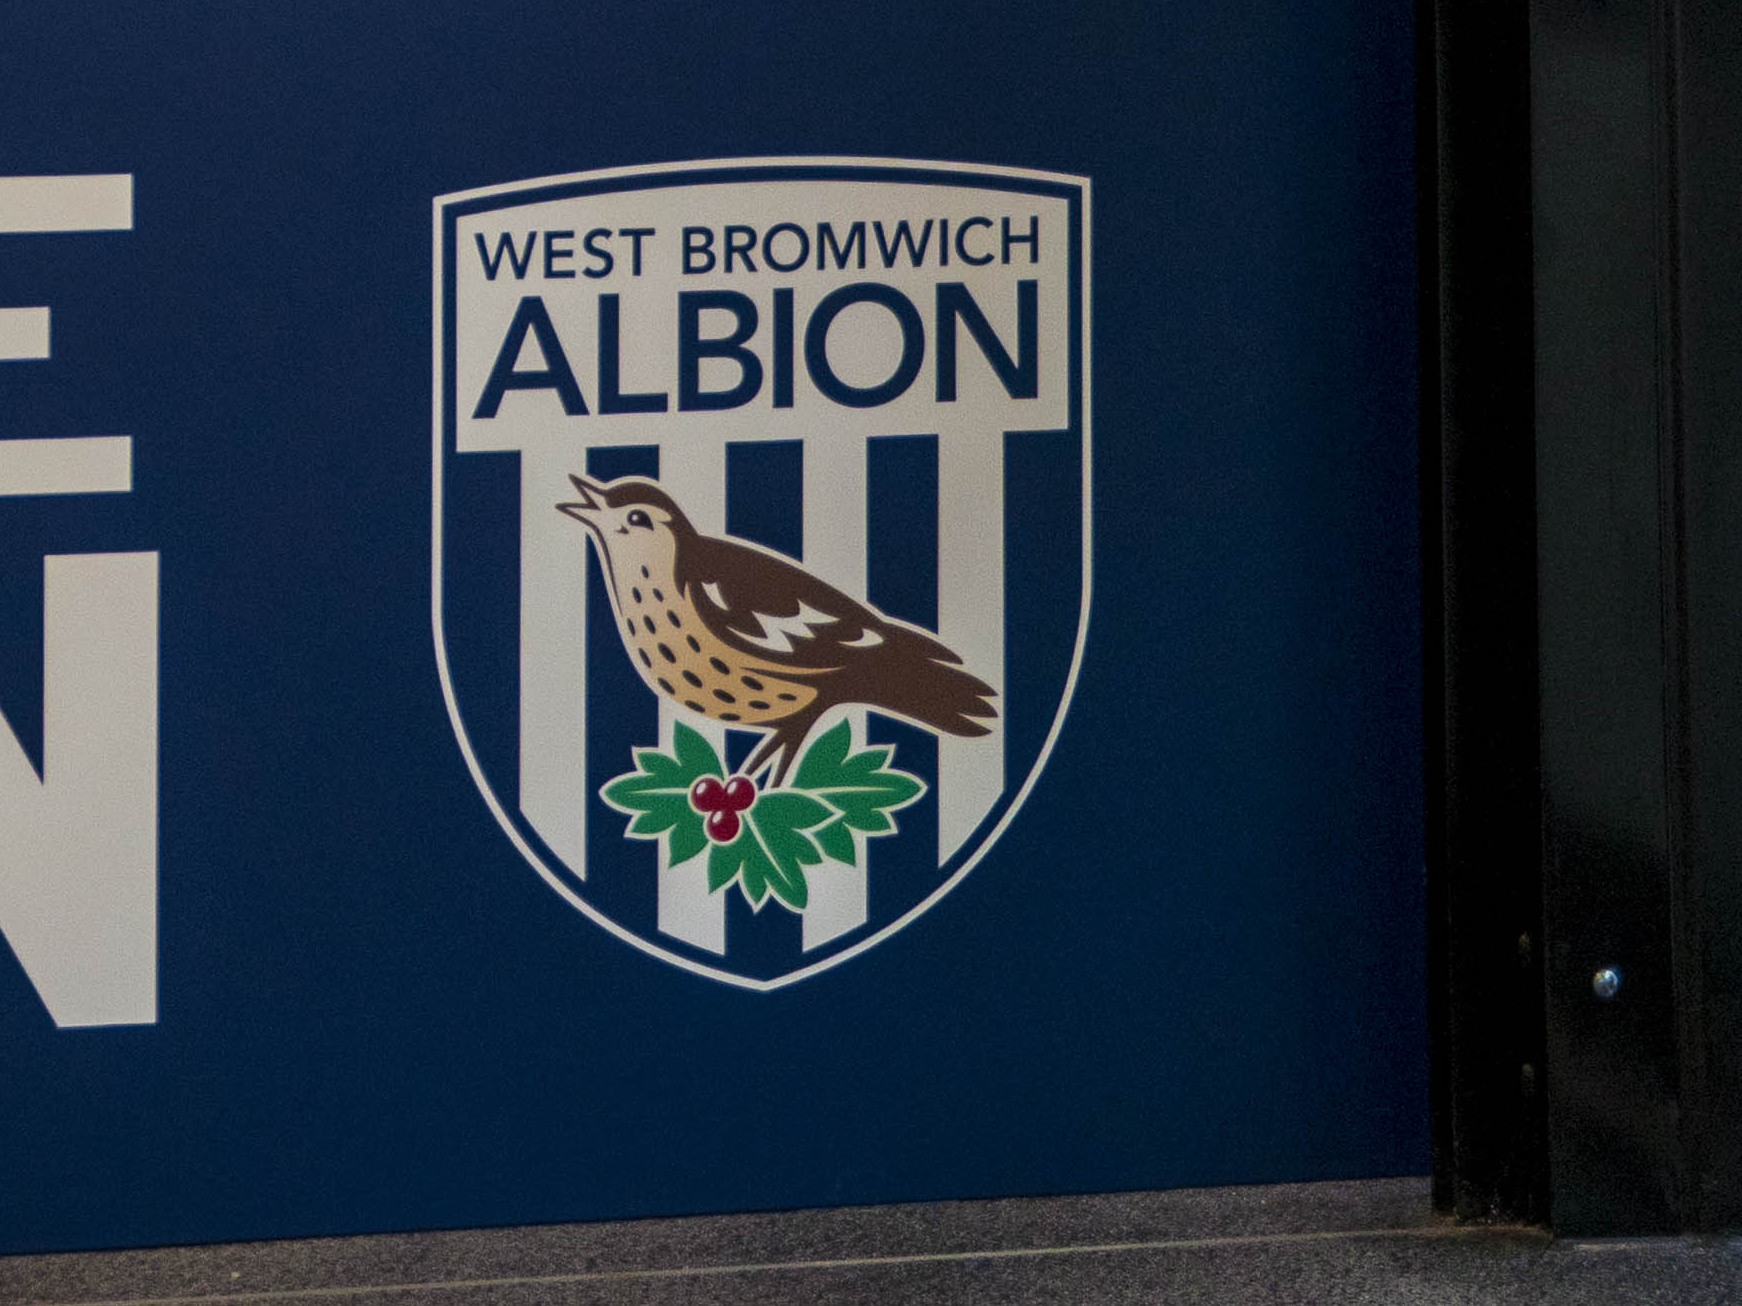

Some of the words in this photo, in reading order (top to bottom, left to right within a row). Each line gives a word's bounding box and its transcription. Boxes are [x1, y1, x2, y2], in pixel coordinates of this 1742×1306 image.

[473, 227, 656, 281] WEST
[681, 215, 1040, 275] BROMWICH
[471, 278, 1040, 421] ALBION
